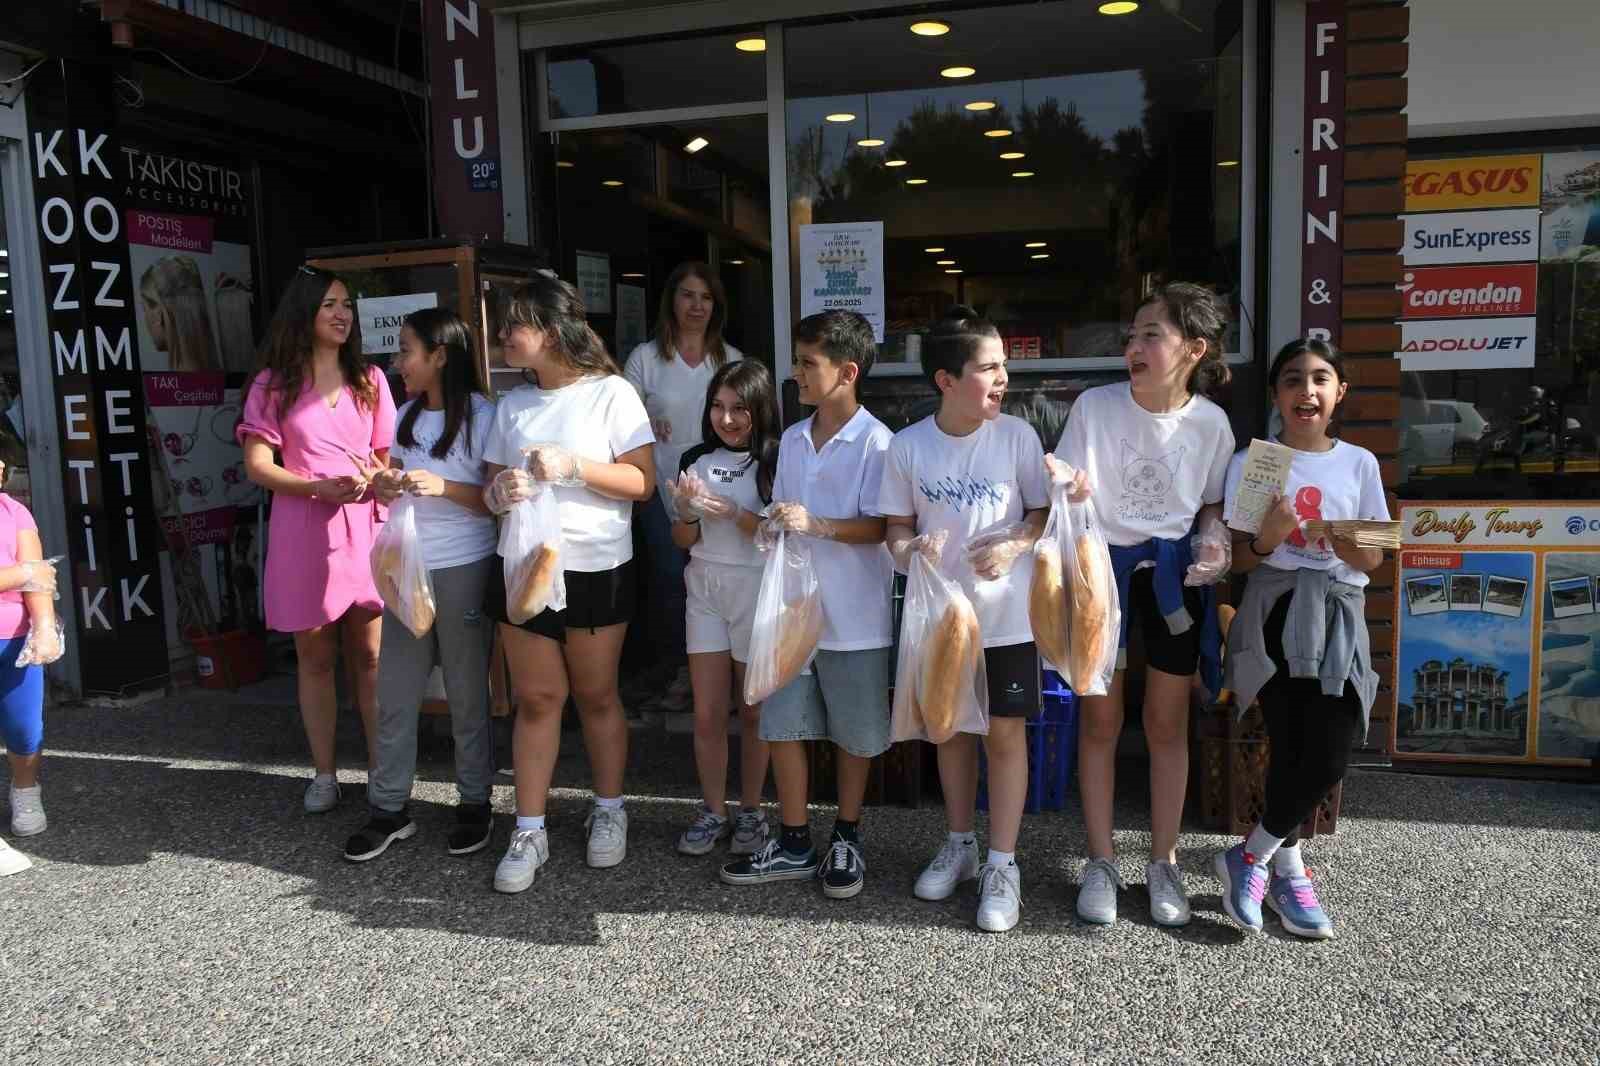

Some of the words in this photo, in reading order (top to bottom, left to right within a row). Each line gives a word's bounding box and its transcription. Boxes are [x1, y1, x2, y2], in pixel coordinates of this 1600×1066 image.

[1306, 22, 1338, 244] FIRIN
[1413, 228, 1531, 251] SunExpress
[1409, 282, 1522, 306] corendon
[1460, 304, 1521, 313] AIRLINES
[382, 335, 394, 346] 10
[712, 468, 728, 476] NEW
[1412, 508, 1476, 543] Daily
[1484, 508, 1543, 537] Tours
[1412, 554, 1450, 567] Ephesus
